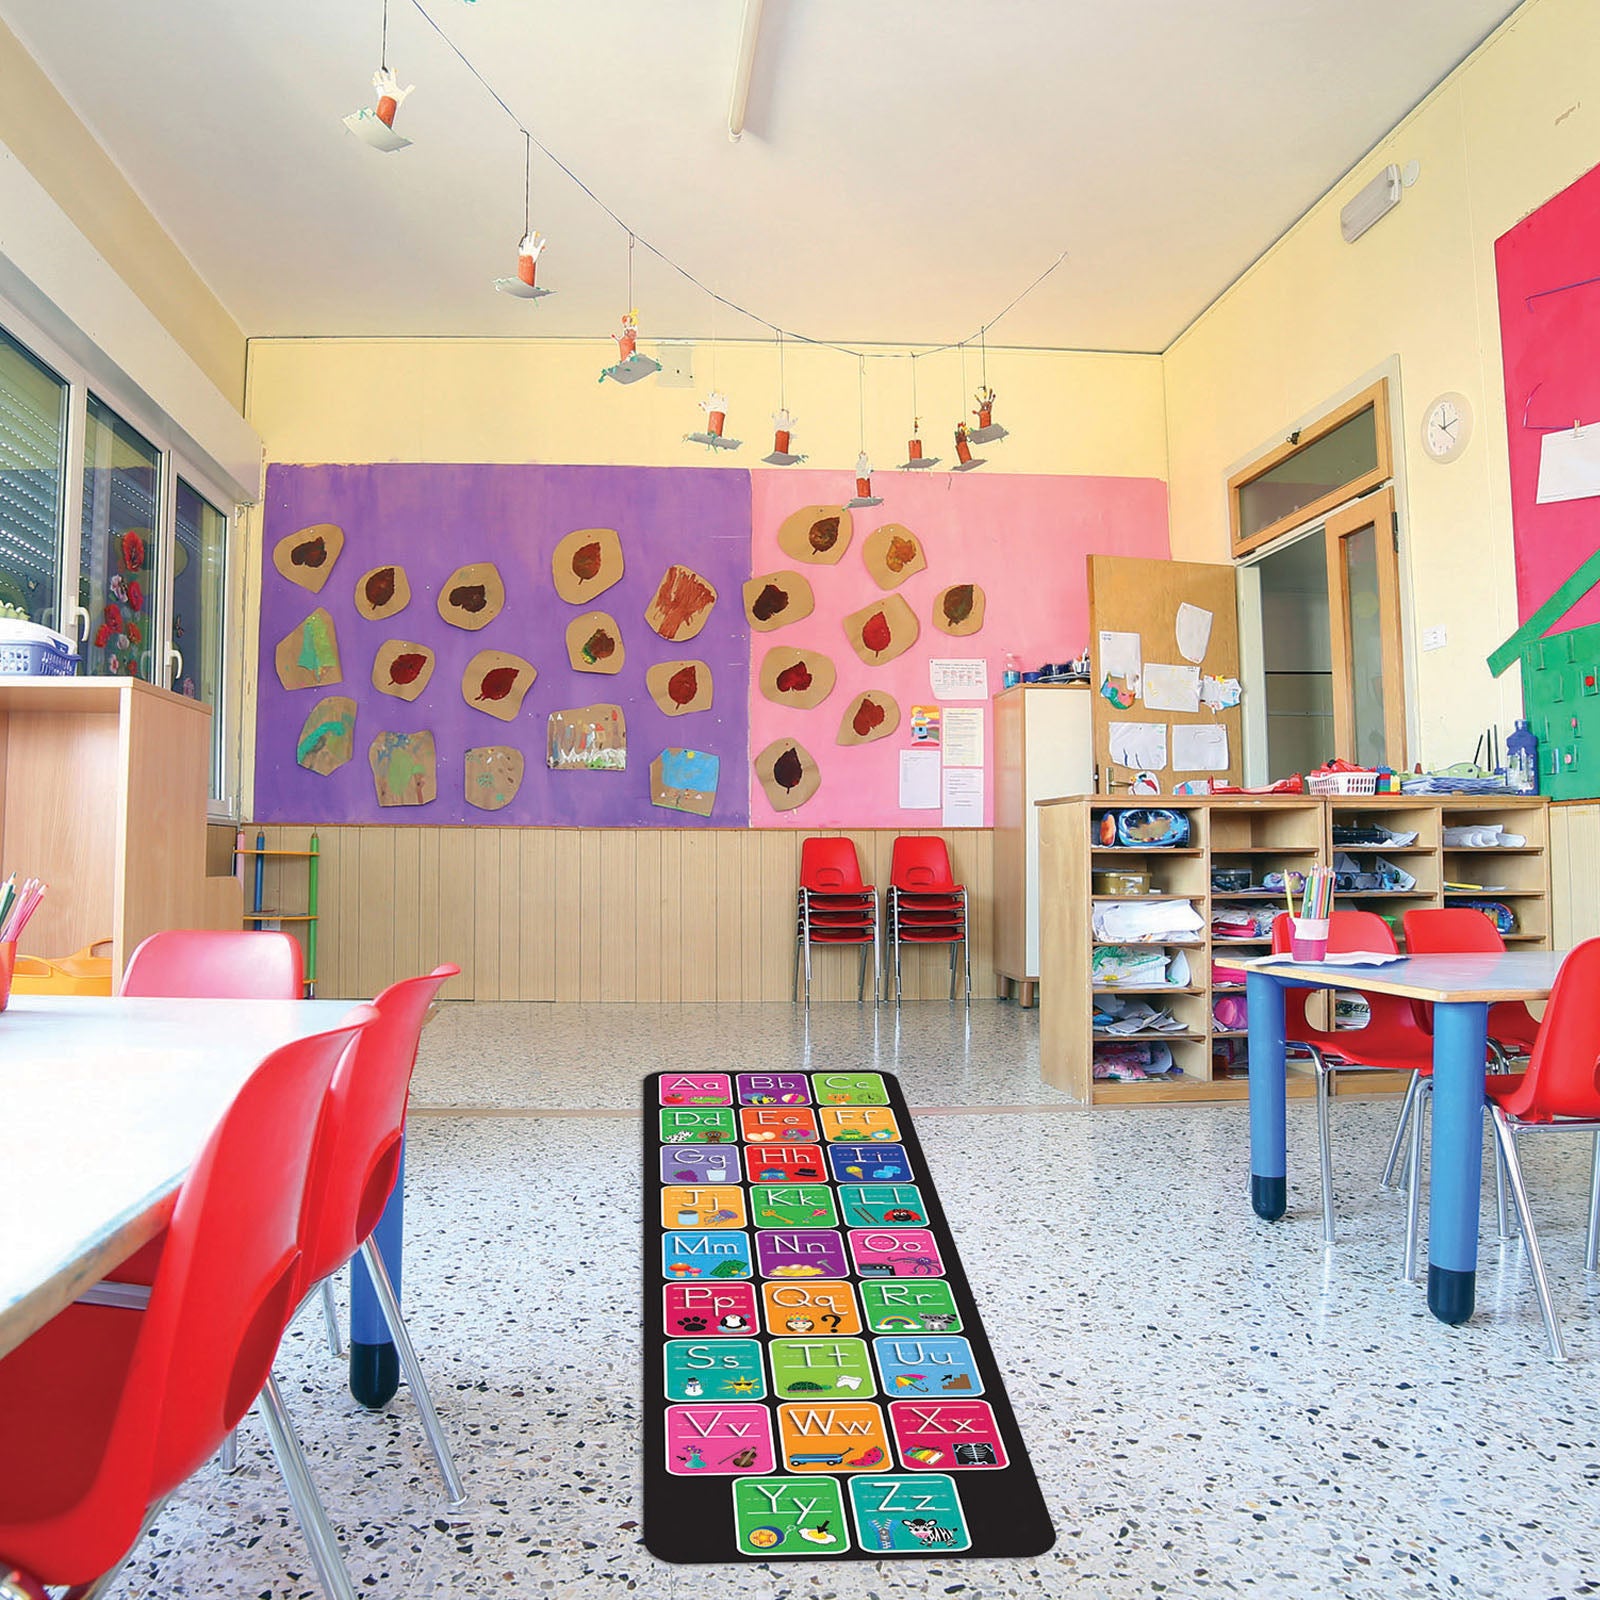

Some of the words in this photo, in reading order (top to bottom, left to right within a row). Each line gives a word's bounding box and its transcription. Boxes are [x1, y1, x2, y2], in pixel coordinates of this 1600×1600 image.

[670, 1077, 719, 1090] Aa
[751, 1077, 794, 1090] Bb
[826, 1077, 869, 1089] Cc
[675, 1112, 720, 1126] Dd
[759, 1112, 799, 1125] Ee
[836, 1111, 879, 1125] Ff
[674, 1149, 726, 1169] Gg
[761, 1149, 810, 1164] Hh
[681, 1190, 719, 1213] Jj
[767, 1189, 817, 1206] Kk
[674, 1236, 738, 1255] Mm
[774, 1235, 826, 1254] Nn
[864, 1234, 921, 1252] Oo
[684, 1288, 735, 1316] Pp
[773, 1287, 848, 1315] Qq
[881, 1286, 932, 1305] Rr
[687, 1346, 739, 1369] Ss
[789, 1344, 849, 1367] Tt
[894, 1343, 952, 1366] Uu
[685, 1411, 750, 1437] Vv
[789, 1410, 872, 1435] Ww
[911, 1407, 976, 1434] Xx
[757, 1485, 816, 1525] Yy
[872, 1482, 935, 1511] Zz
